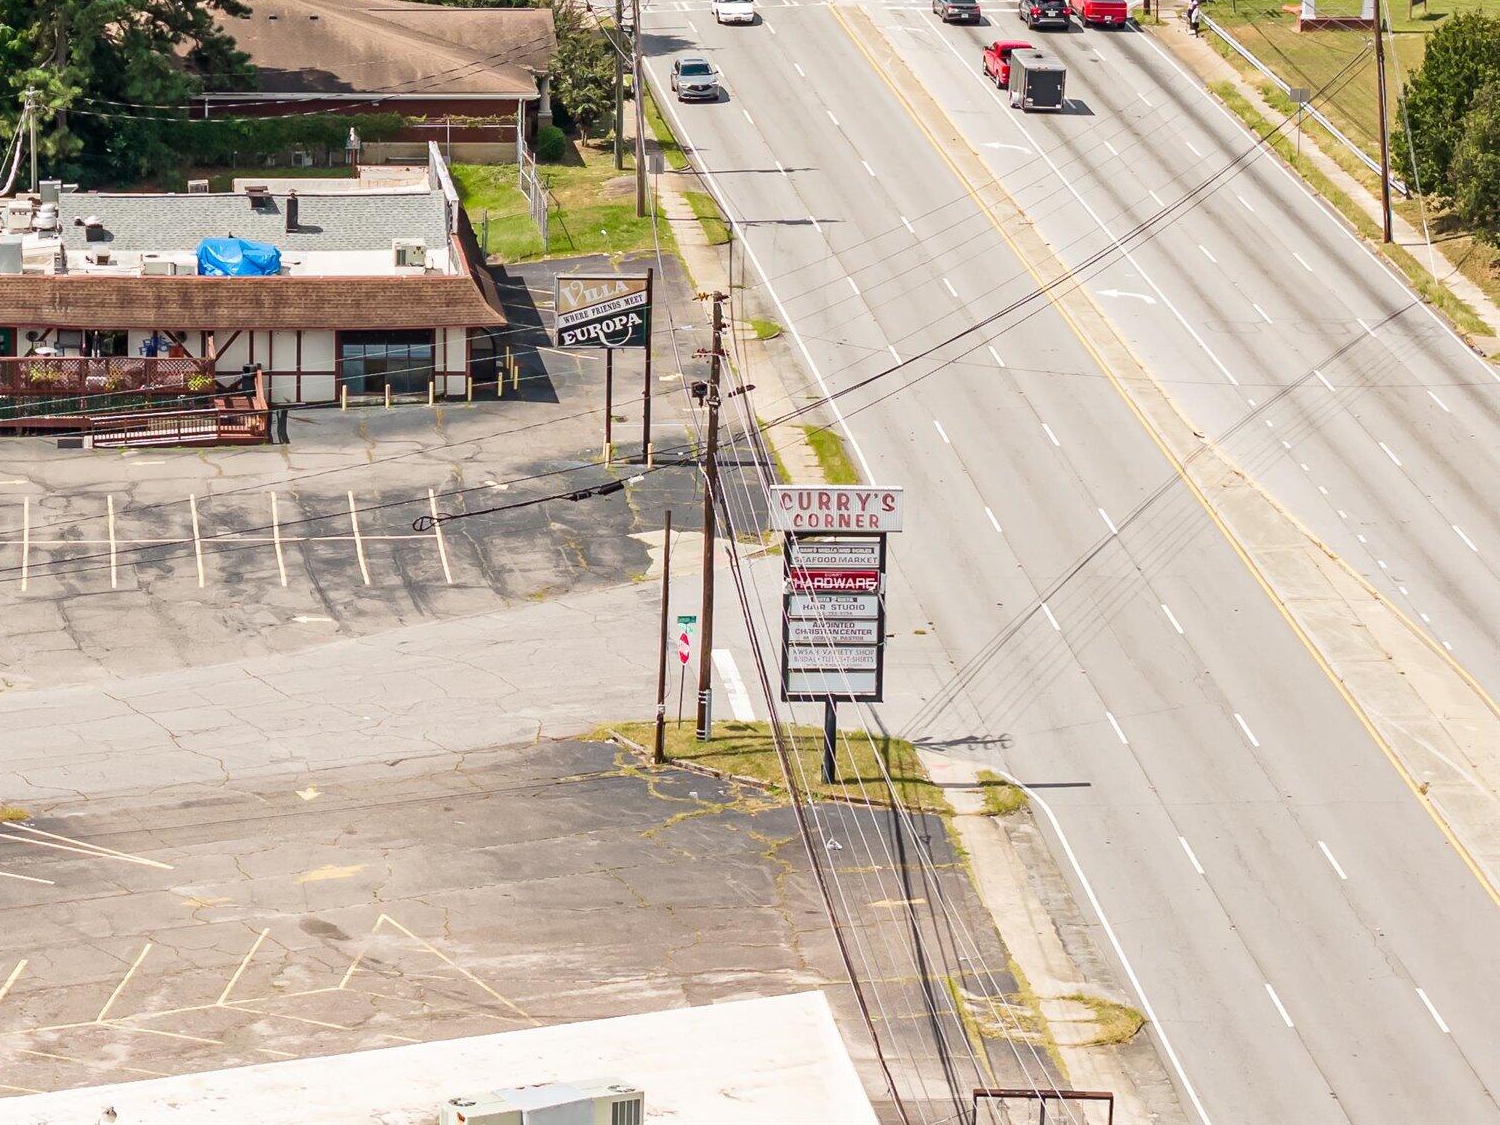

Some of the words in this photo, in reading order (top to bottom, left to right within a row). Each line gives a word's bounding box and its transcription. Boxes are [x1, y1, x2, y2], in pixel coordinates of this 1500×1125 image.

[563, 311, 588, 324] WHERE
[591, 301, 622, 316] FRIENDS
[624, 294, 643, 306] MEET
[561, 313, 643, 346] EUROPA
[780, 491, 896, 512] CURRY'S
[793, 513, 879, 529] CORNER
[795, 556, 837, 564] SEAFOOD
[838, 556, 878, 564] MARKET
[794, 578, 877, 590] HARDWARE
